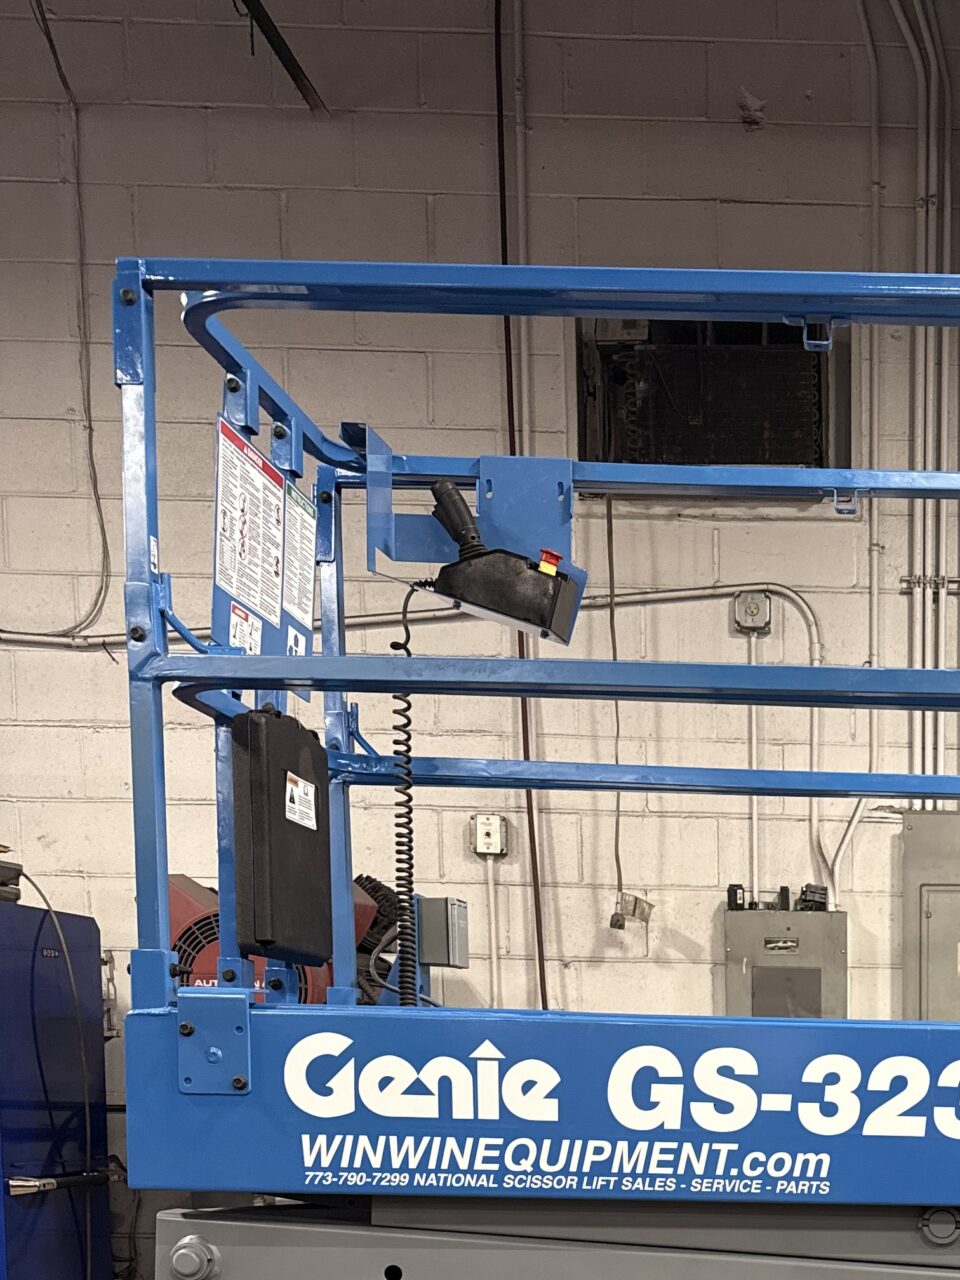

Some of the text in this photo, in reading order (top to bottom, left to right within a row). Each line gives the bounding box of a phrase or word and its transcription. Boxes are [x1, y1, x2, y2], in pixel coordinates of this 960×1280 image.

[284, 1032, 562, 1121] Genie
[302, 1135, 831, 1178] WINWINEQUIPMENT.com
[304, 1172, 410, 1186] 773-790-7299
[413, 1173, 499, 1188] NATIONAL
[502, 1175, 579, 1189] SCISSOR
[581, 1176, 619, 1190] LIFT
[621, 1177, 677, 1191] SALES
[690, 1179, 763, 1193] SERVICE
[775, 1180, 831, 1195] PARTS
